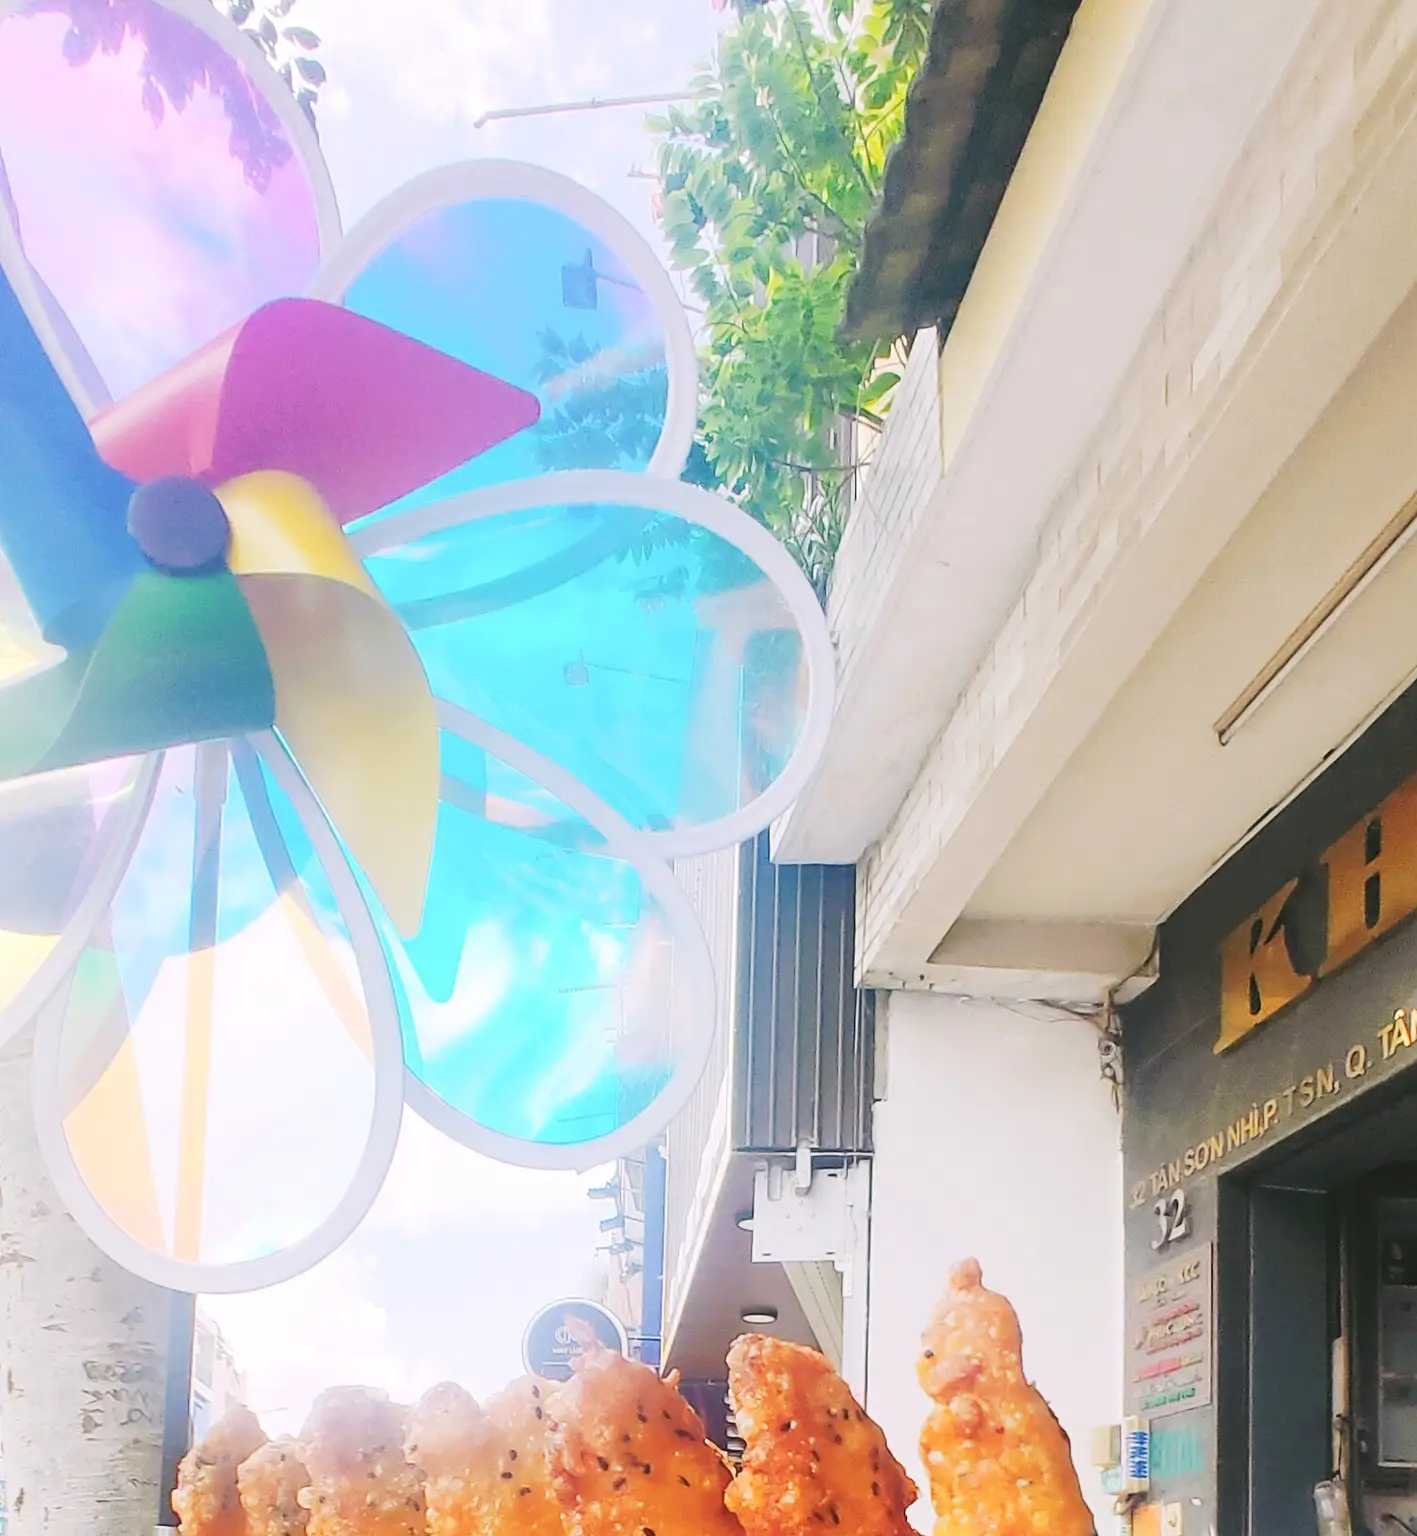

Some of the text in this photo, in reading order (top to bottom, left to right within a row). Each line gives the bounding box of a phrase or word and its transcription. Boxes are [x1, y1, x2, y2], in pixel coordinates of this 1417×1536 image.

[1129, 1180, 1146, 1210] 32
[1149, 1158, 1181, 1197] TÂN
[1183, 1131, 1224, 1177] SƠN
[1345, 1044, 1372, 1079] Q.
[1150, 1188, 1186, 1250] 32
